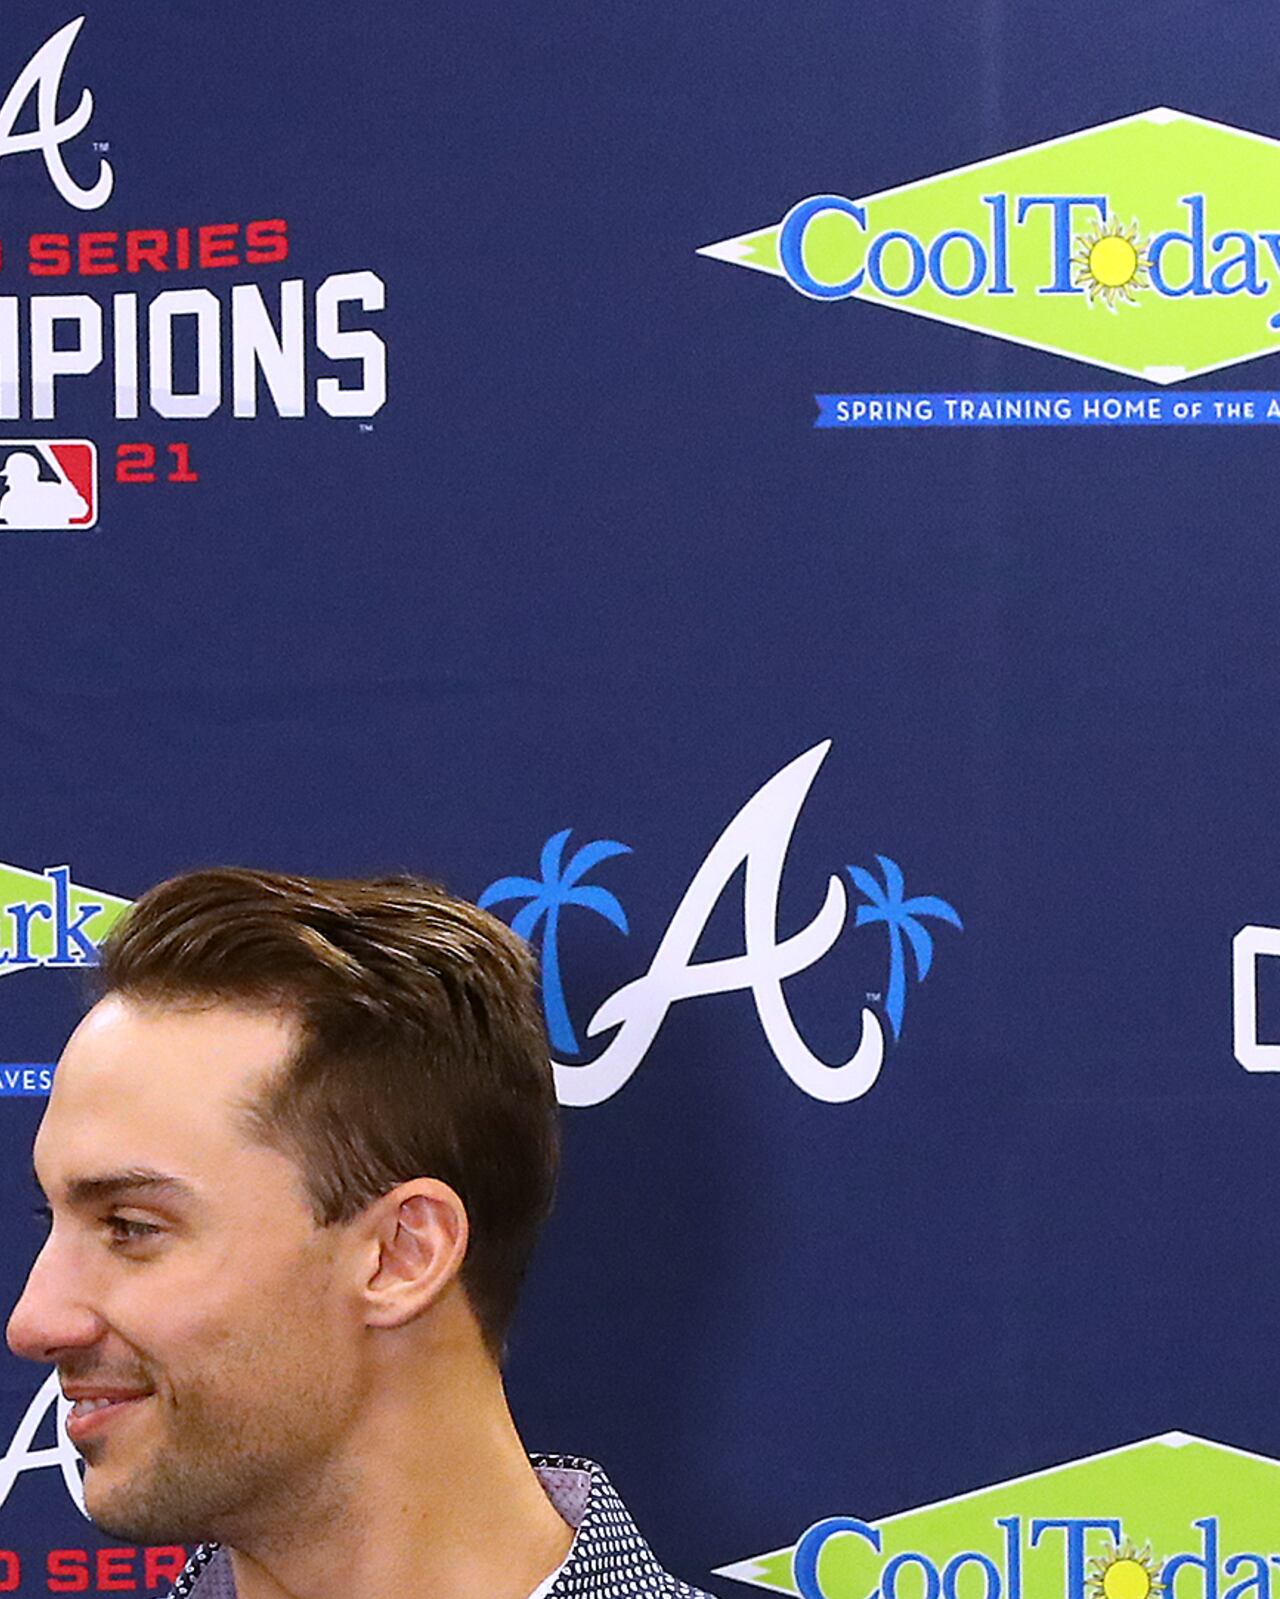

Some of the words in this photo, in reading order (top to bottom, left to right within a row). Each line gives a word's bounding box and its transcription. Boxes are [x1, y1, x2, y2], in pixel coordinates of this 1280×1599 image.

[28, 219, 289, 276] SERIES
[837, 399, 933, 422] SPRING
[944, 398, 1072, 421] TRAINING
[1083, 398, 1162, 420] HOME
[1173, 402, 1202, 419] OF
[1213, 402, 1255, 419] THE
[115, 442, 198, 483] 21
[551, 739, 884, 1107] A
[47, 1545, 187, 1592] SER
